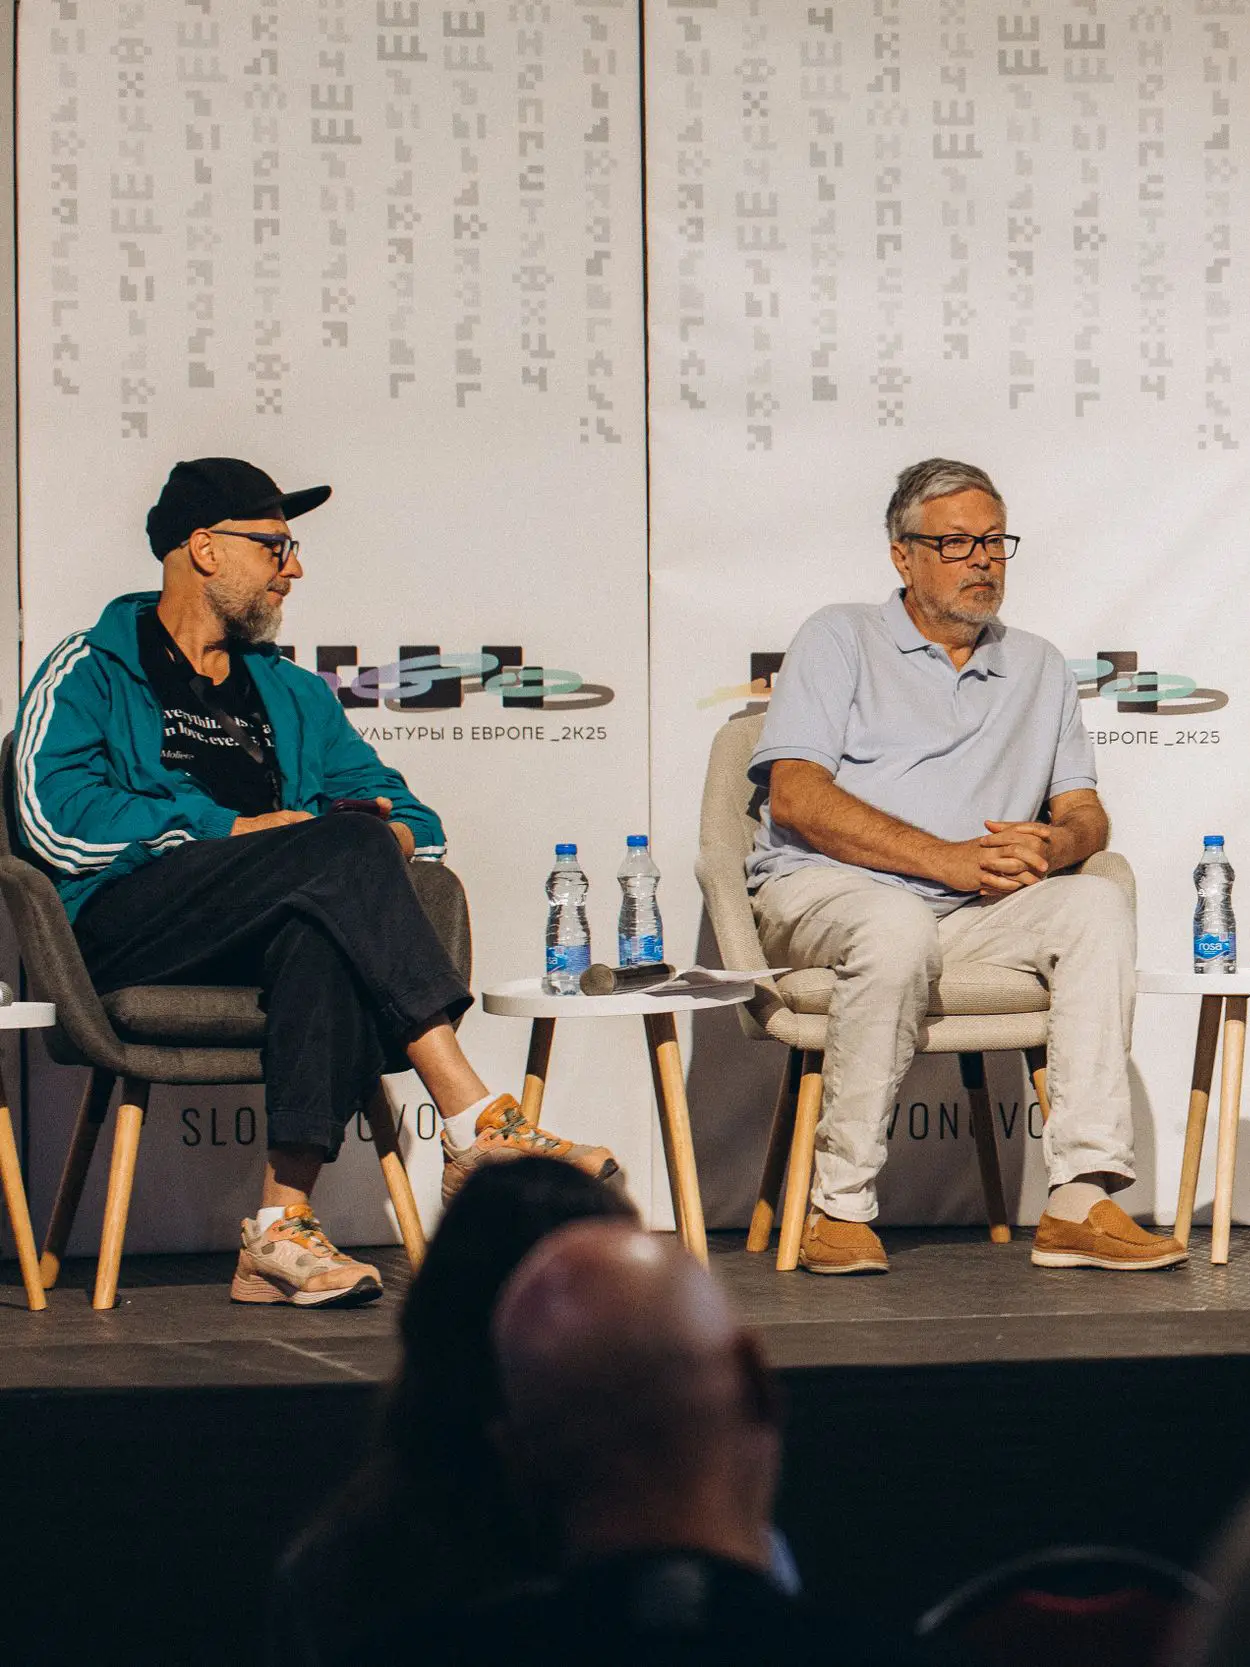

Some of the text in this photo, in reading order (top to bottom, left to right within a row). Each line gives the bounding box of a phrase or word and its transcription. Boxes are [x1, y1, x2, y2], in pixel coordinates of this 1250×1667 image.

[358, 726, 445, 741] УЛЬТУРЫ
[452, 726, 465, 741] В
[471, 726, 545, 741] ЕВРОПЕ
[1198, 941, 1223, 951] rosa
